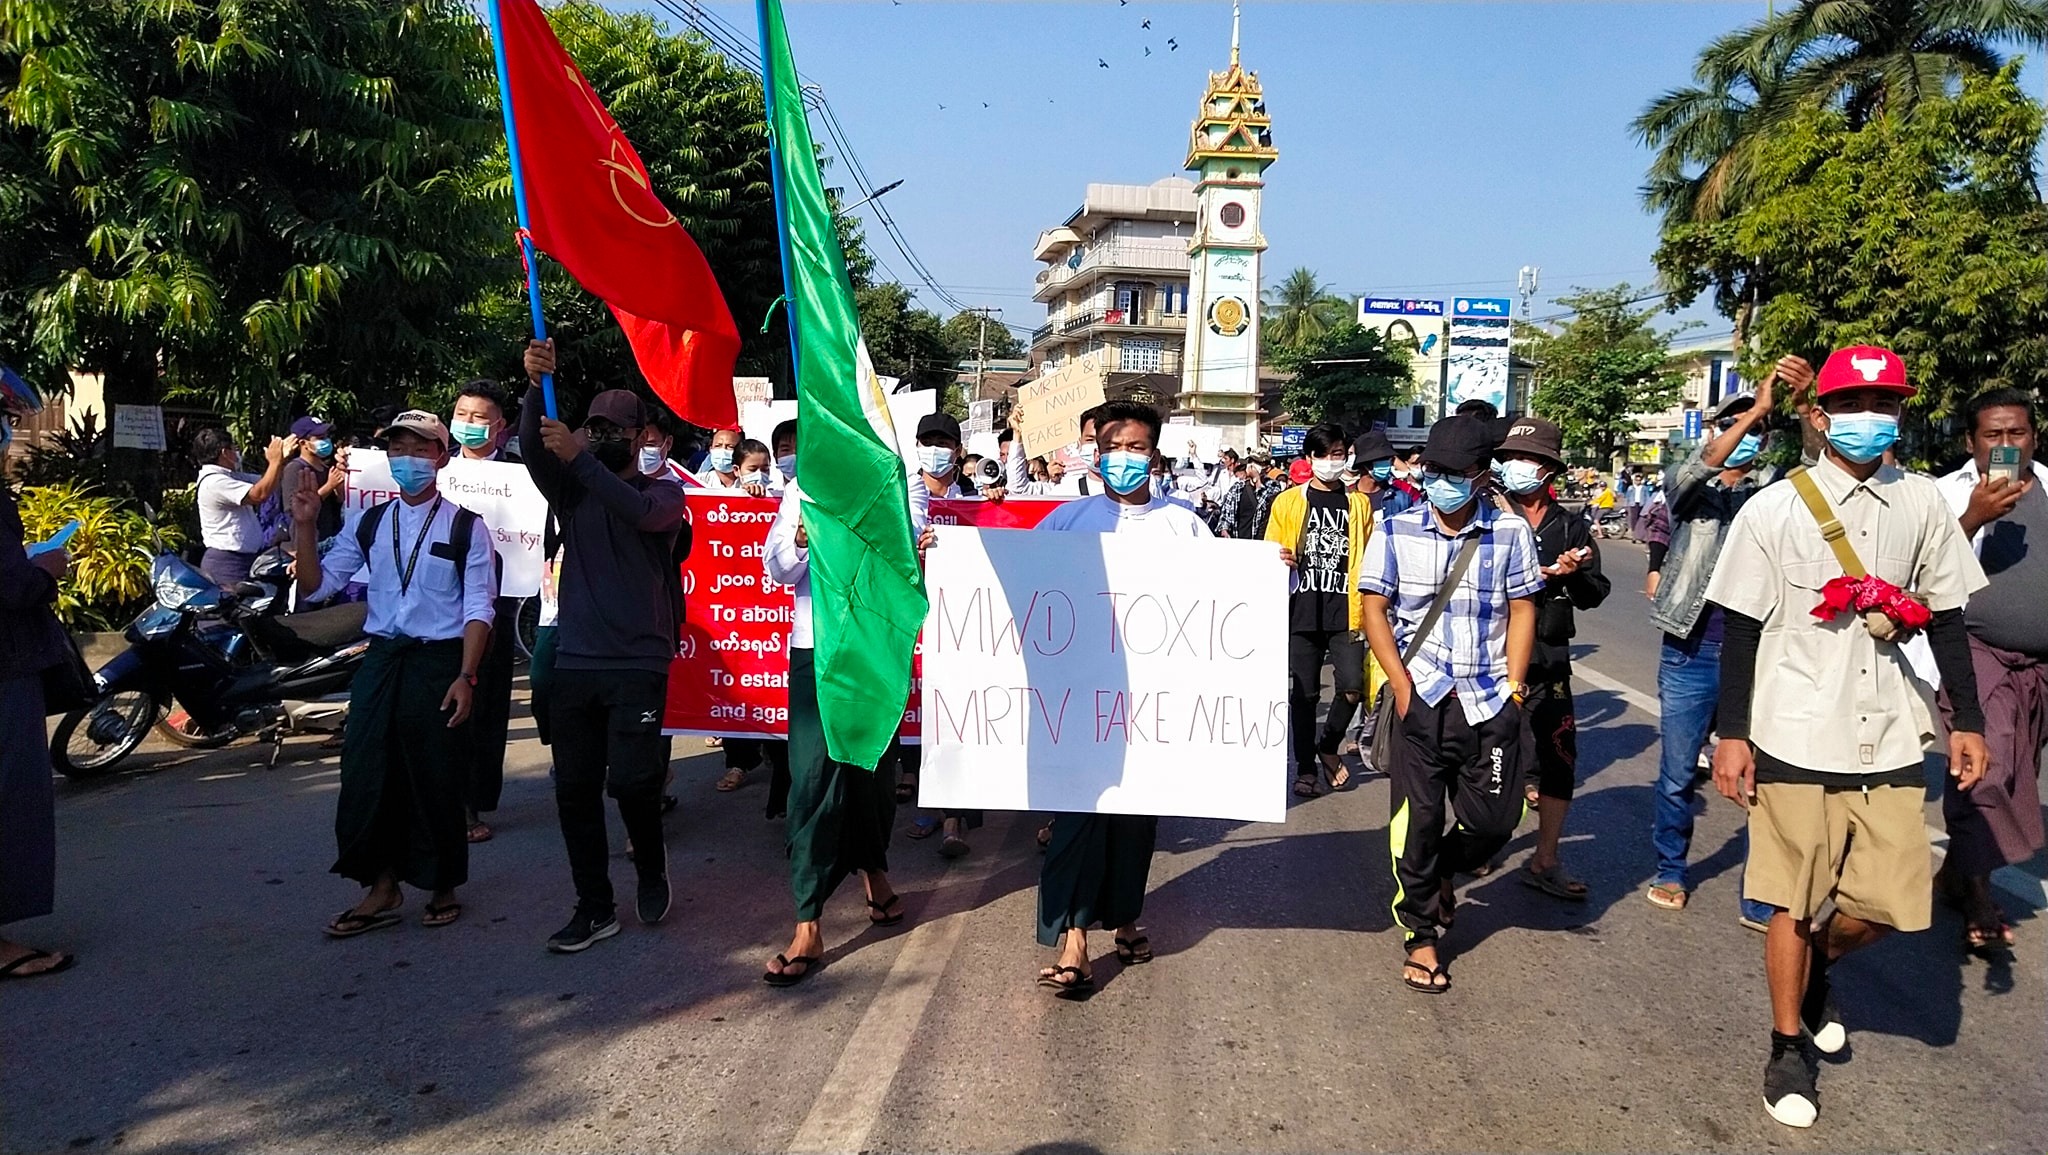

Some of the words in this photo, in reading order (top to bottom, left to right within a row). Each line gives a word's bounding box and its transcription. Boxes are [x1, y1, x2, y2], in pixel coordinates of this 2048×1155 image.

[1029, 368, 1072, 400] MRTV
[1083, 360, 1094, 374] &
[1045, 385, 1087, 414] MWD
[1027, 422, 1063, 448] FAKE
[449, 476, 512, 498] President
[497, 527, 512, 544] Su
[520, 528, 541, 551] Kyi
[708, 540, 734, 557] To
[709, 604, 736, 622] To
[937, 587, 1075, 656] MWD
[1097, 592, 1254, 661] TOXIC
[709, 669, 734, 686] To
[710, 702, 746, 718] and
[935, 686, 1070, 745] MRTV
[1096, 690, 1169, 745] FAKE
[1189, 694, 1287, 749] NEWS
[1490, 747, 1503, 783] Sport
